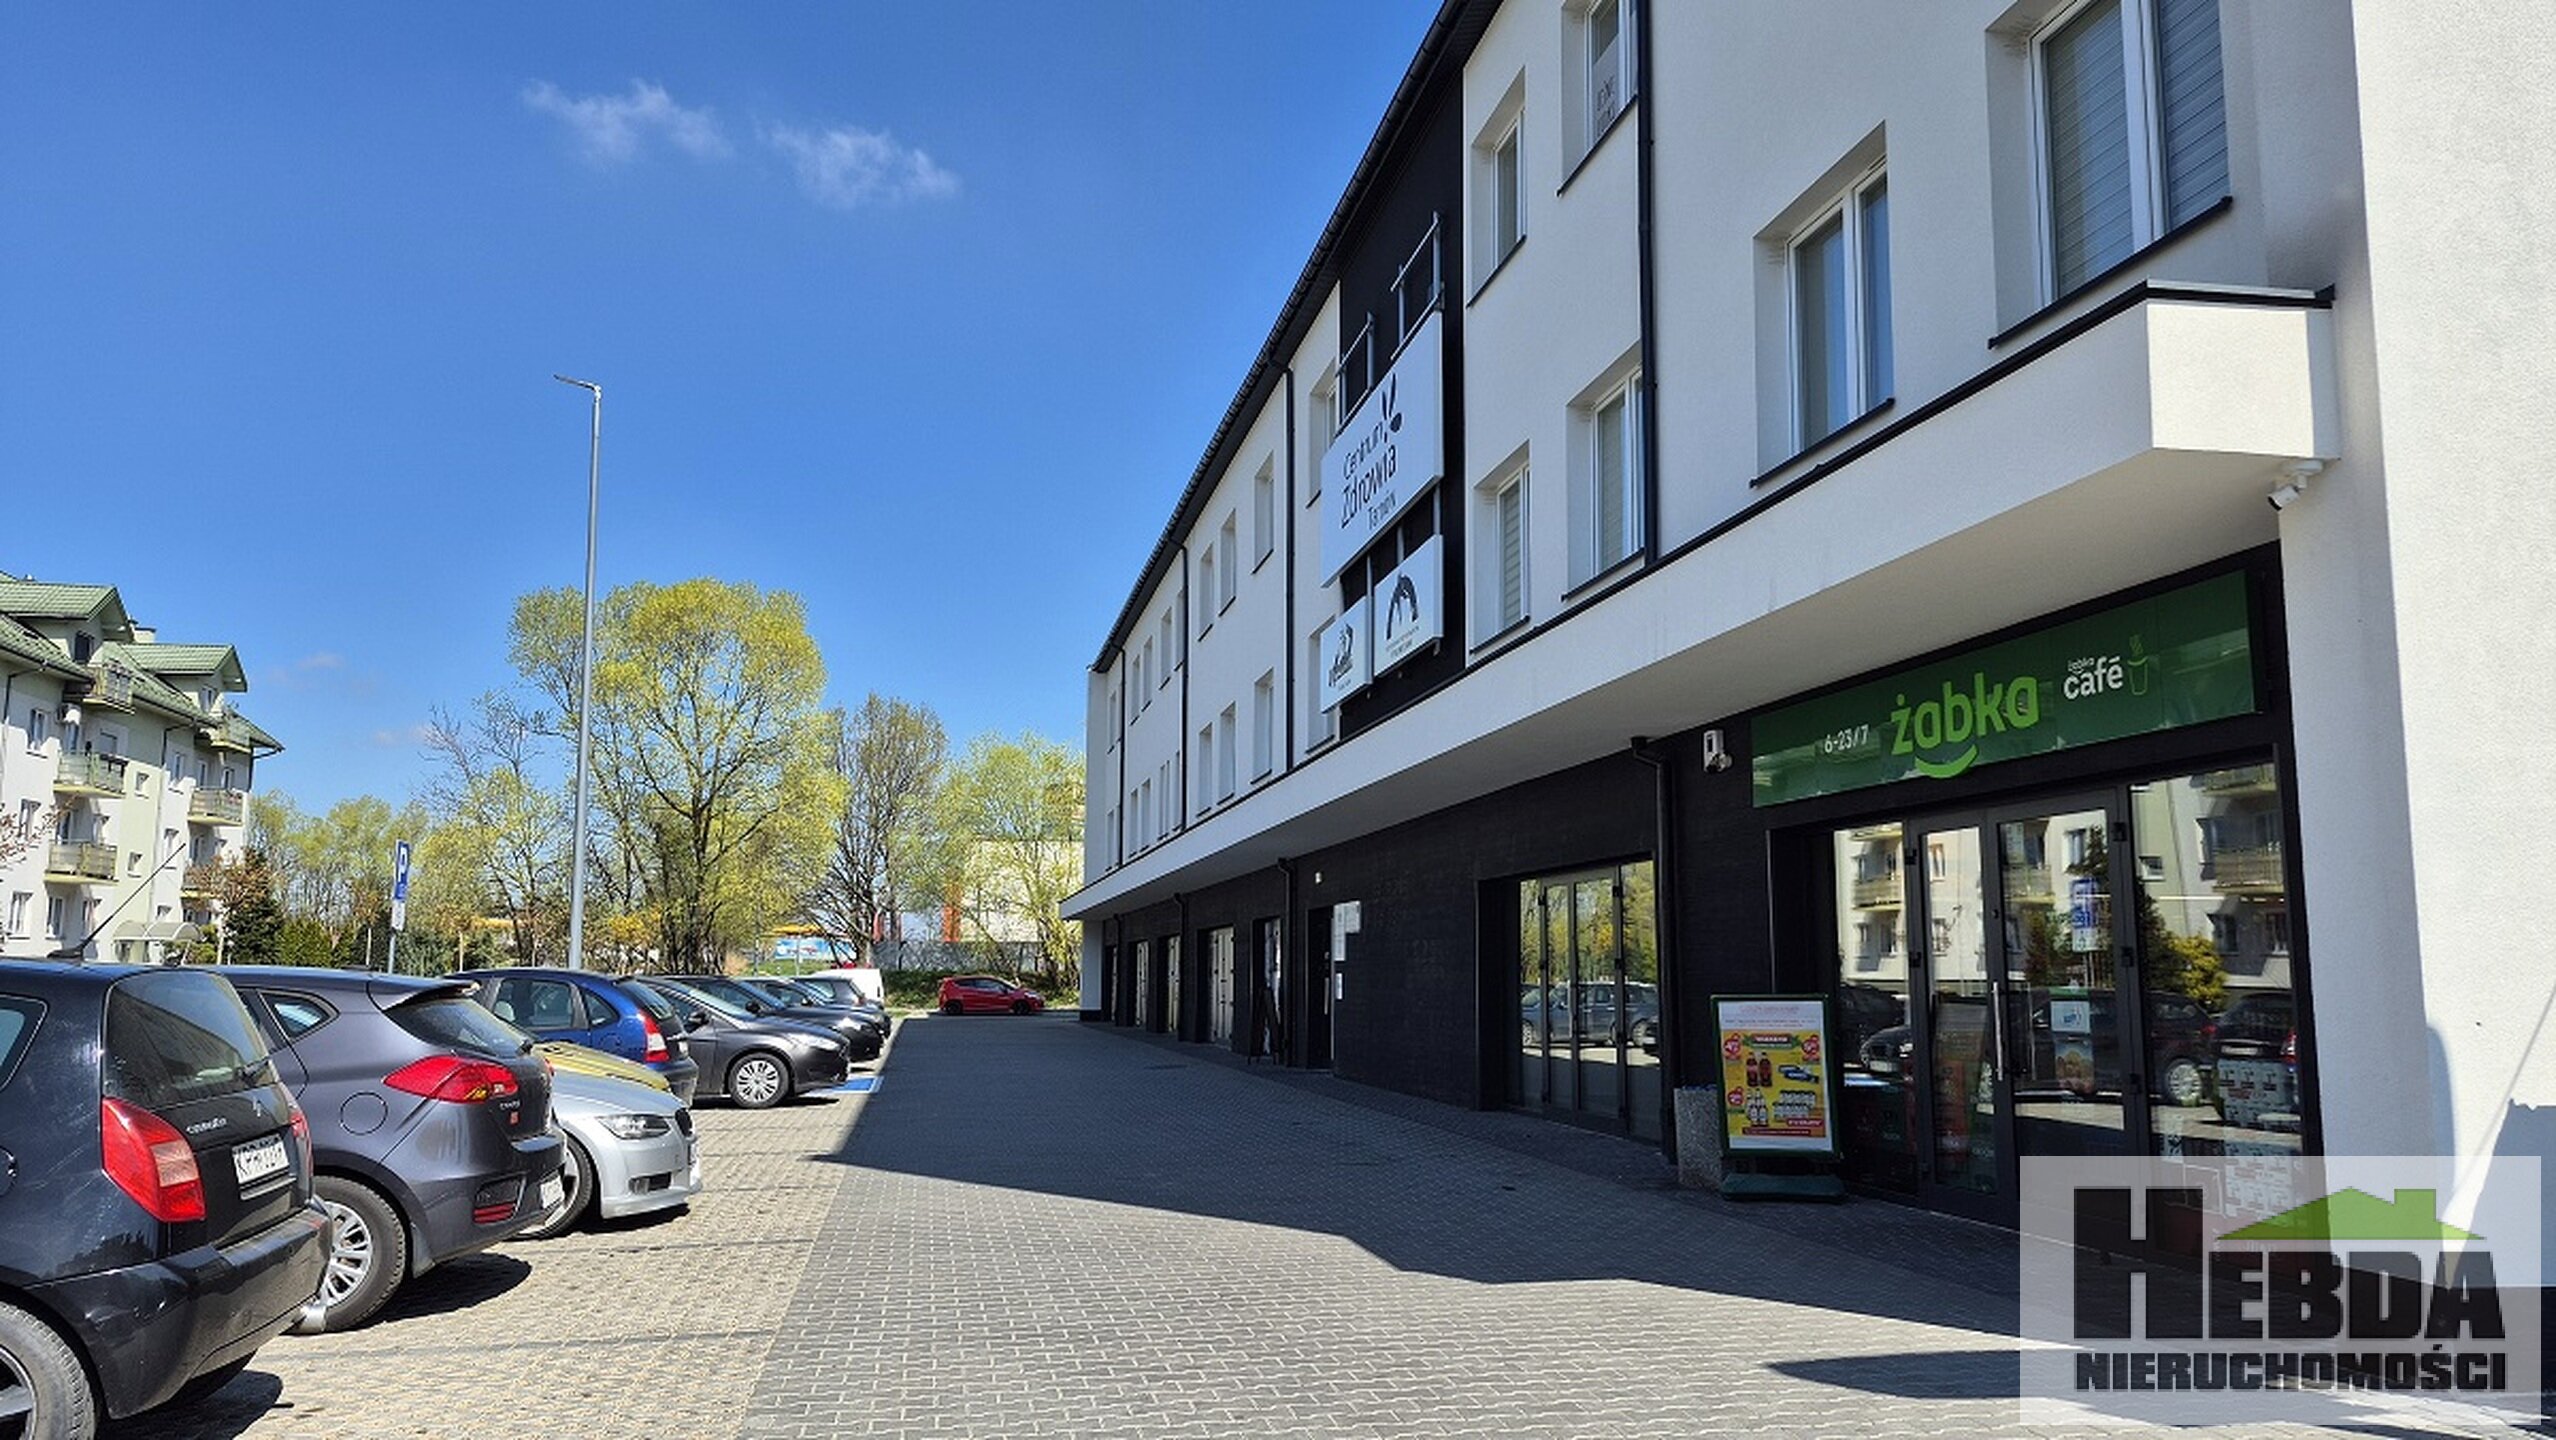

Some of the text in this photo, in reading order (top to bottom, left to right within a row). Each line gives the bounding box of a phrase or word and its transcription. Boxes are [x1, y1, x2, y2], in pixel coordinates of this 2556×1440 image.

[1343, 421, 1387, 480] Centrum
[1341, 444, 1396, 529] Zdrowia
[2064, 656, 2123, 699] café
[1825, 724, 1869, 753] 6-23/7
[1891, 672, 2039, 756] żabka
